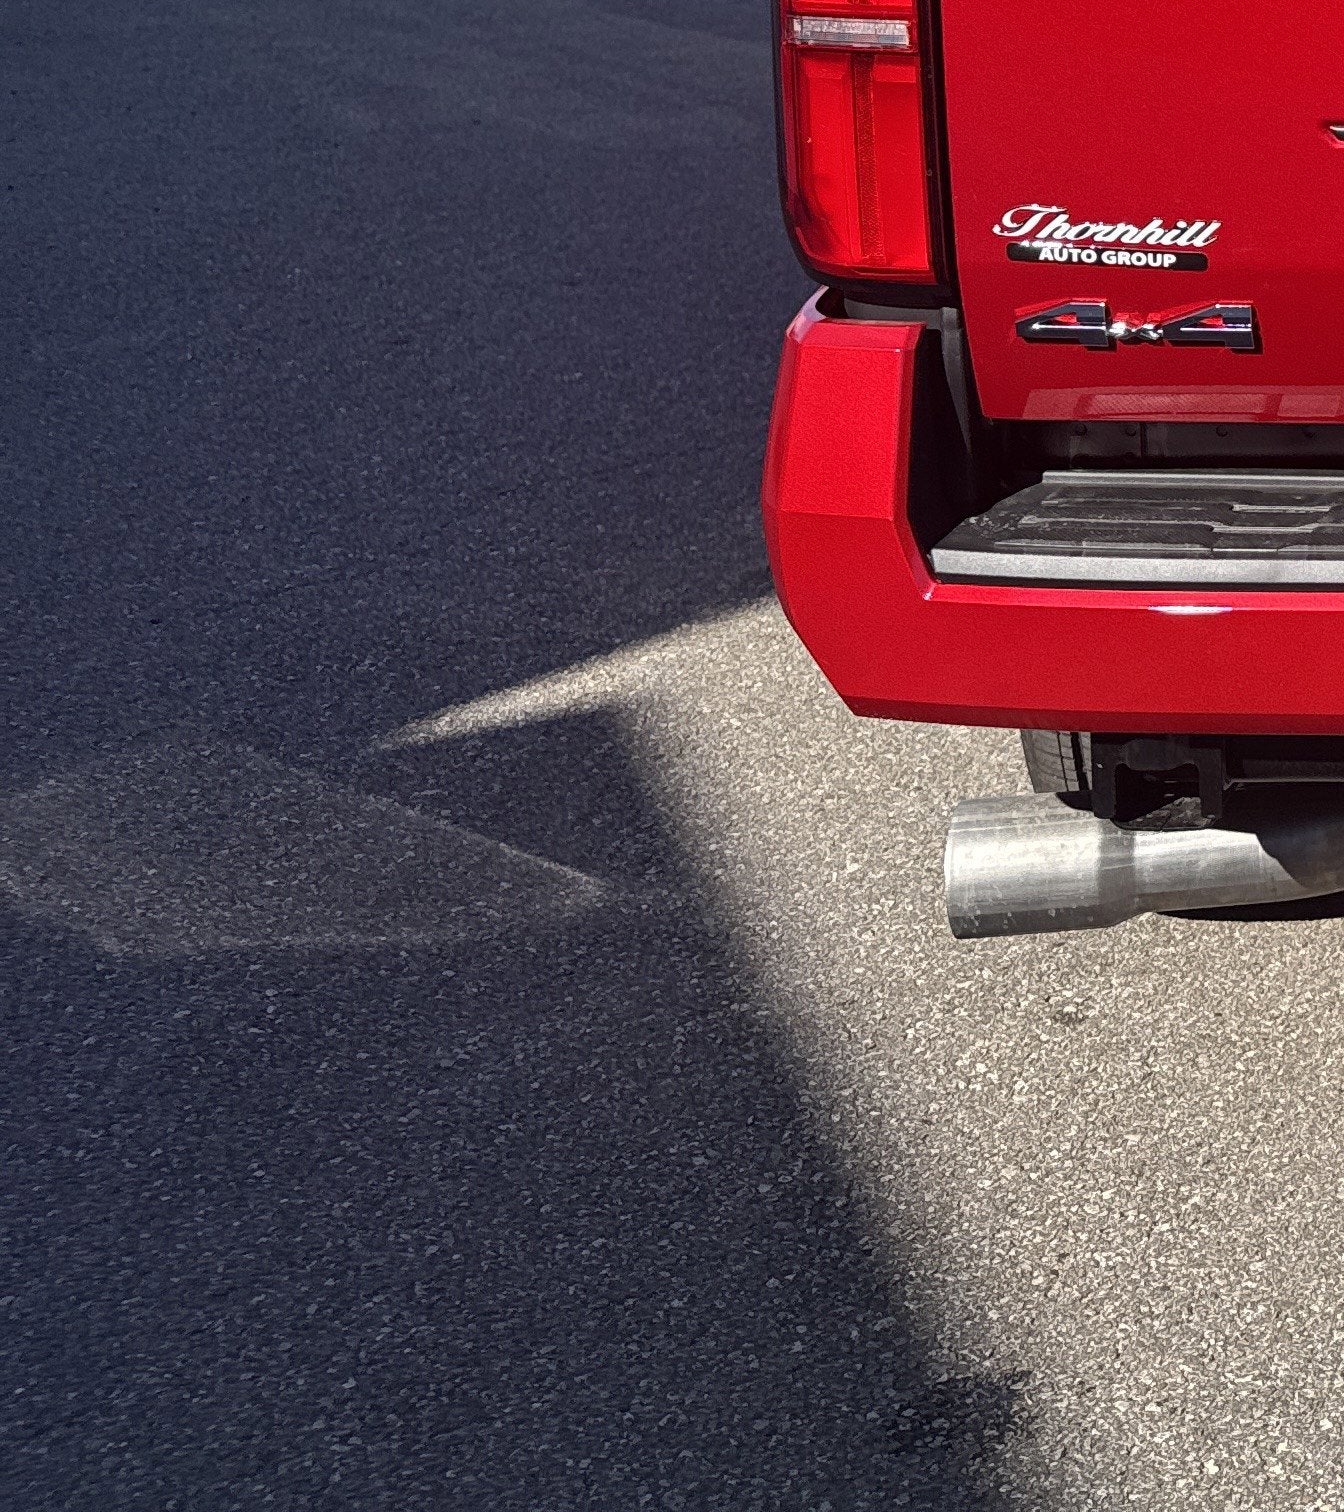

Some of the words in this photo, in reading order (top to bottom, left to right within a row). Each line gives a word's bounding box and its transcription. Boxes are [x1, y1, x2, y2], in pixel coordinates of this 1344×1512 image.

[992, 203, 1222, 248] Thornhill
[1038, 246, 1098, 264] AUTO
[1101, 249, 1177, 268] GROUP
